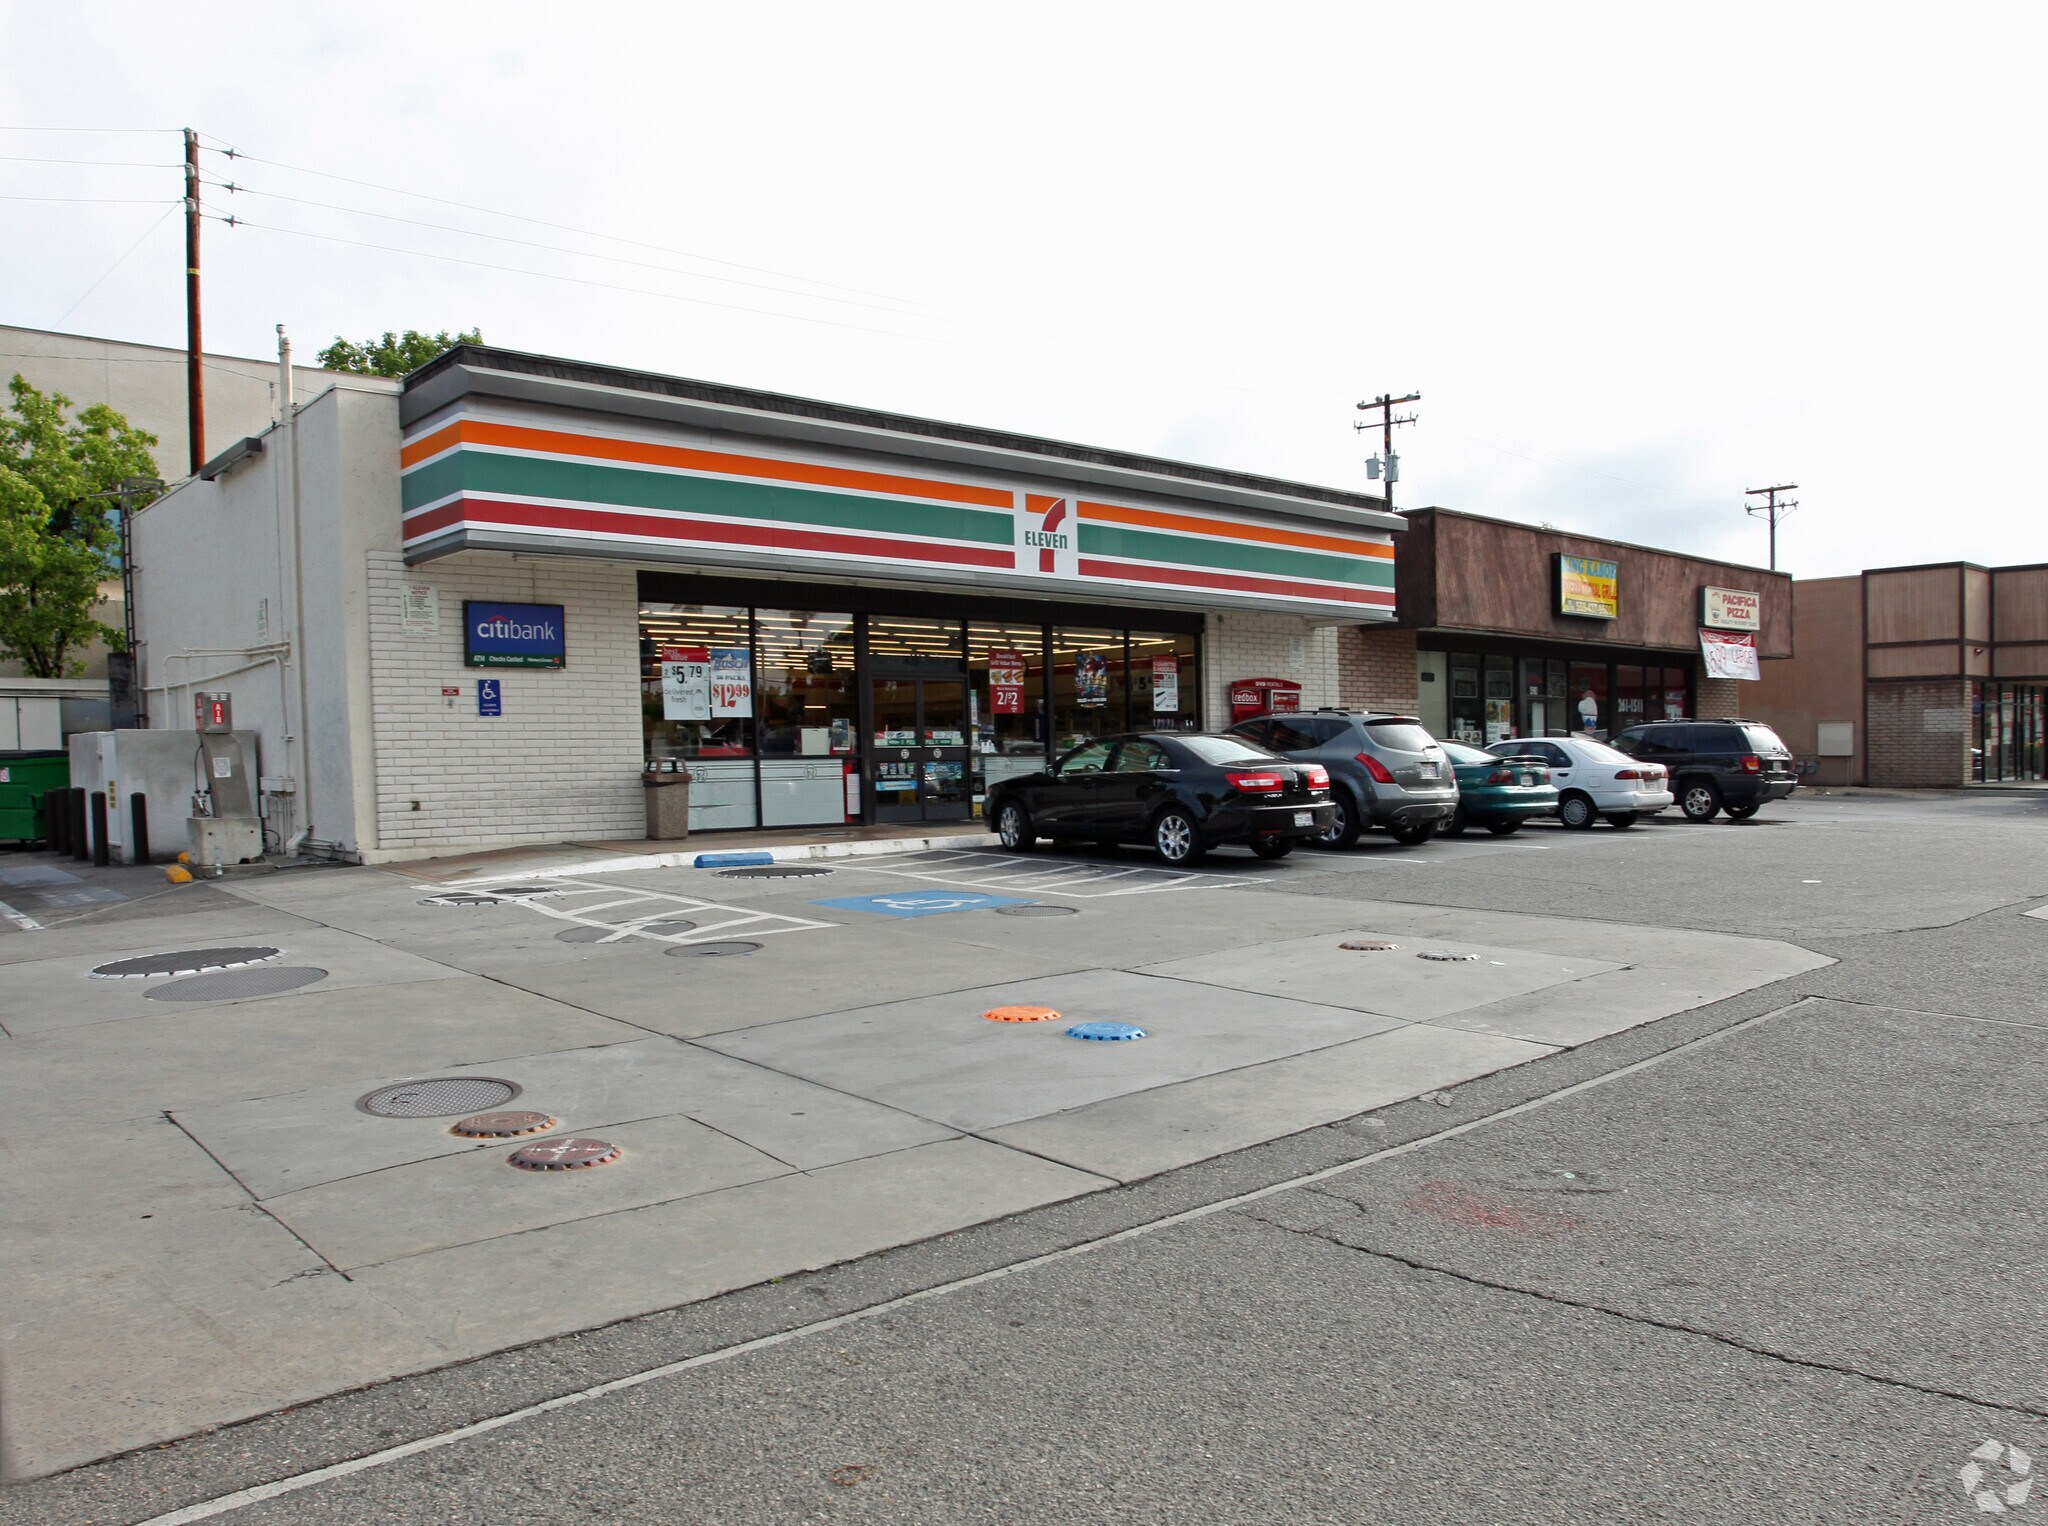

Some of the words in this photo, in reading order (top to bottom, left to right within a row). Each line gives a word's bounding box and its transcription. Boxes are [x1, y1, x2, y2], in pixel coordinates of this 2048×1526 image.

[1039, 497, 1066, 573] 7
[1722, 594, 1757, 608] PACIFICA
[1726, 607, 1751, 619] PIZZA
[477, 619, 556, 641] citibank
[664, 688, 694, 696] delivered
[1234, 693, 1258, 702] redbox
